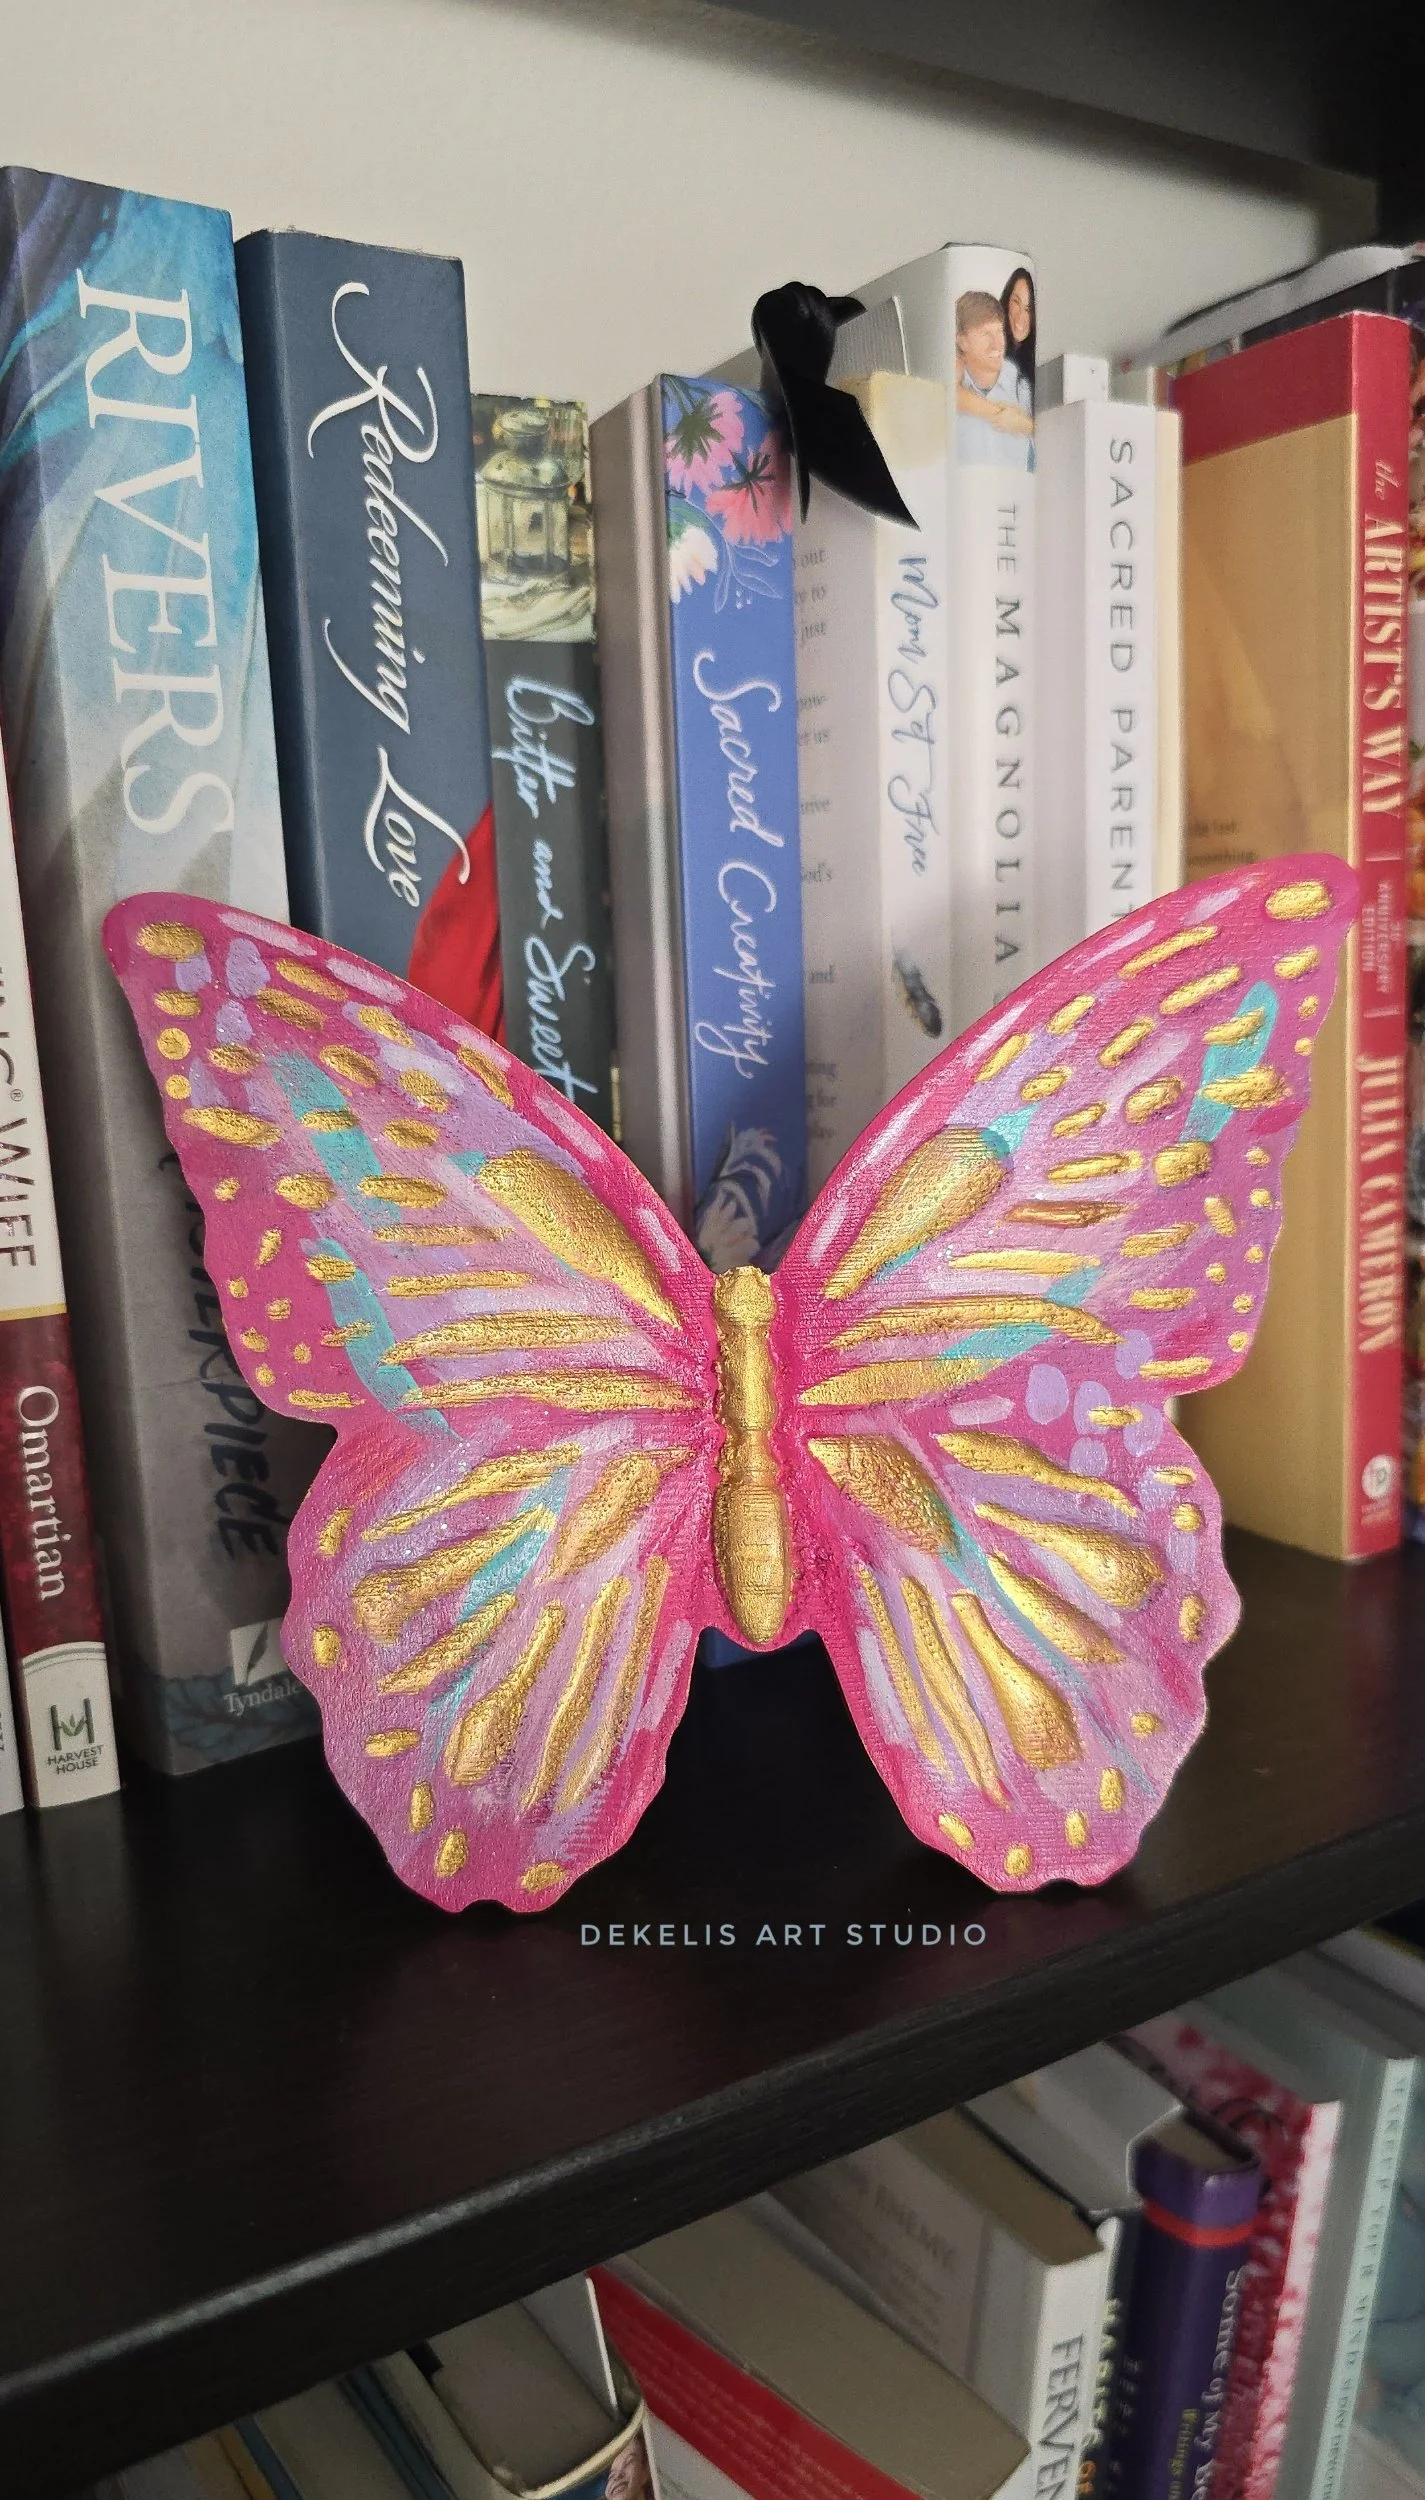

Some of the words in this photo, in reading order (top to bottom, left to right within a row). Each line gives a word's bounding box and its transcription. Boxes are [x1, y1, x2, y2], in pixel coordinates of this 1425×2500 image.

[308, 281, 448, 735] Redeeming
[995, 501, 1017, 575] THE
[1374, 458, 1400, 501] the
[77, 268, 235, 835] RIVERS
[891, 556, 939, 664] Mom
[1109, 438, 1135, 673] SACRED
[1362, 512, 1405, 712] ARTIST'S
[491, 677, 595, 820] Bitter
[692, 649, 784, 848] Sacred
[994, 596, 1021, 964] MAGNOLIA
[1361, 724, 1403, 820] WAY
[364, 744, 471, 908] Love
[533, 838, 564, 931] and
[888, 774, 939, 876] Free
[525, 935, 599, 1099] Sweet
[695, 860, 777, 1079] Creativity
[1355, 1054, 1401, 1163] JULIA
[1357, 1172, 1399, 1355] CAMERON
[18, 1385, 72, 1602] Omartian
[46, 1744, 105, 1767] HARVEST
[55, 1758, 100, 1776] HOUSE
[1200, 2376, 1229, 2404] of
[1211, 2265, 1250, 2377] Some
